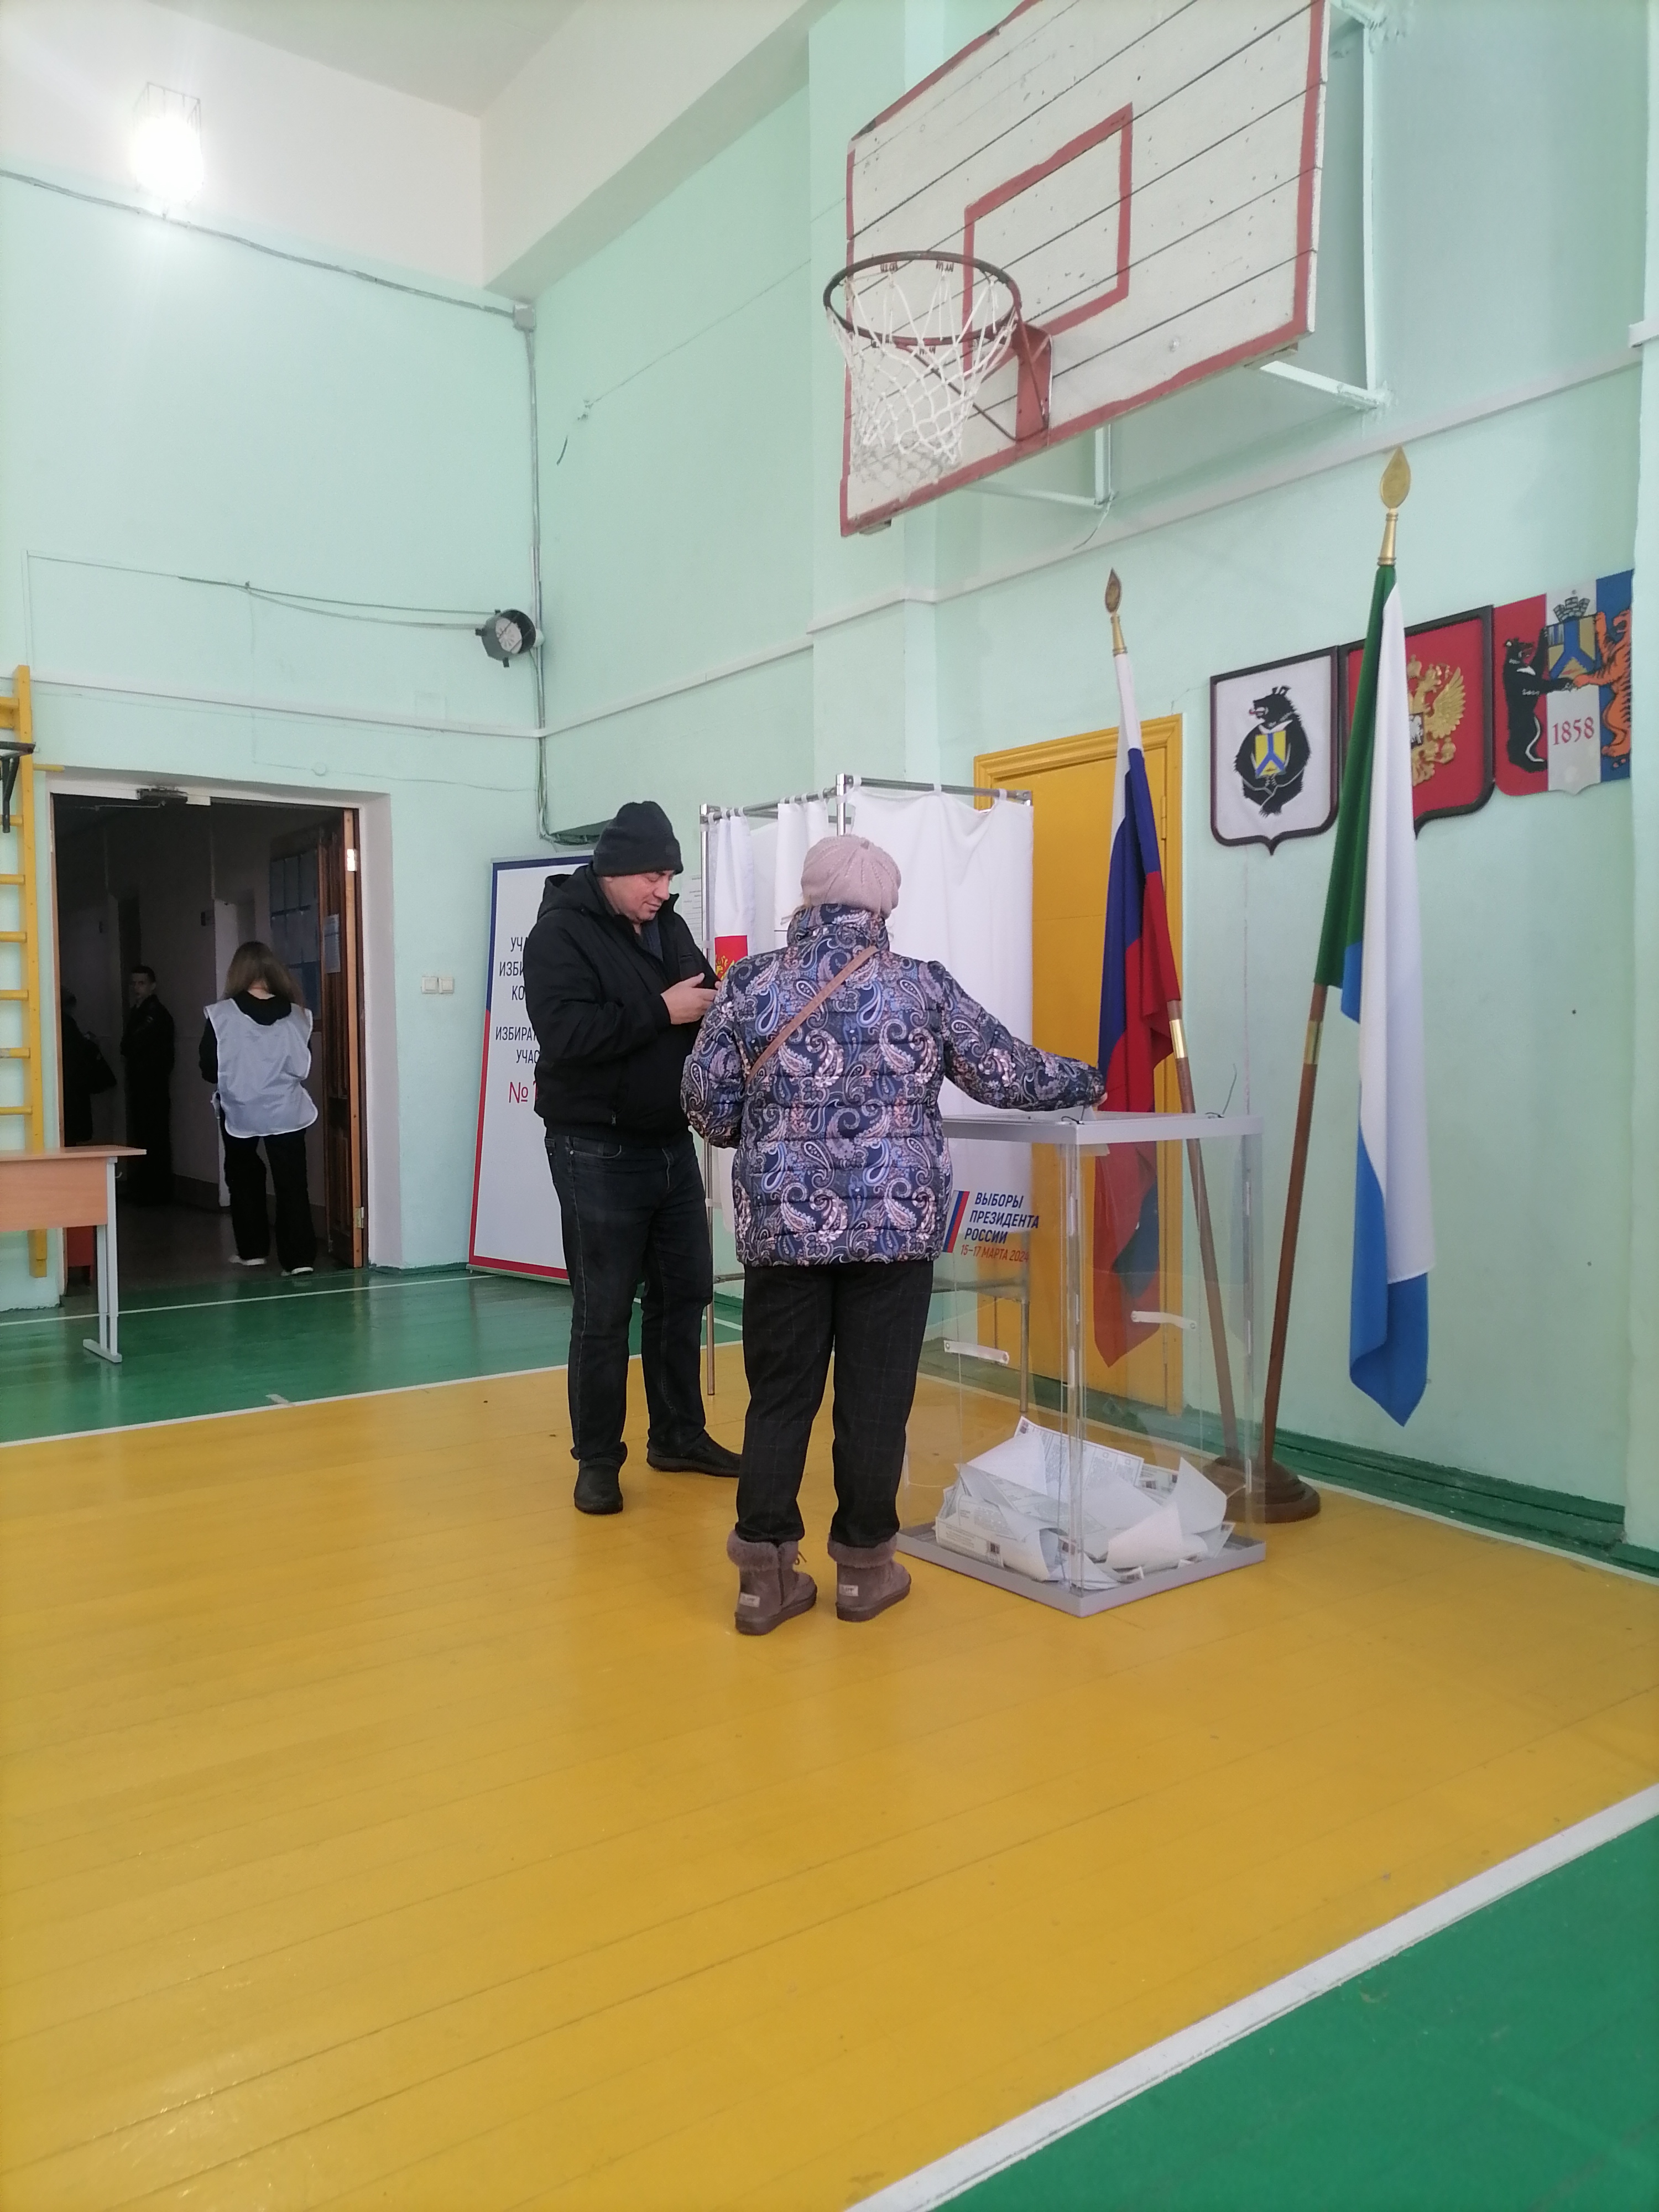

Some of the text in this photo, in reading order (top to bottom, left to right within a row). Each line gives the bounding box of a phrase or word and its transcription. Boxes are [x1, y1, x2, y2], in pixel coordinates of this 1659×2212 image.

[1552, 716, 1594, 745] 1858
[510, 937, 528, 952] УЧ
[974, 1192, 1024, 1208] ВЫБОРЫ
[969, 1211, 1039, 1228] ПРЕЗИДЕНТА
[964, 1228, 1008, 1244] РОССИИ
[981, 1246, 1008, 1260] МАРТА
[1009, 1250, 1029, 1262] 2024
